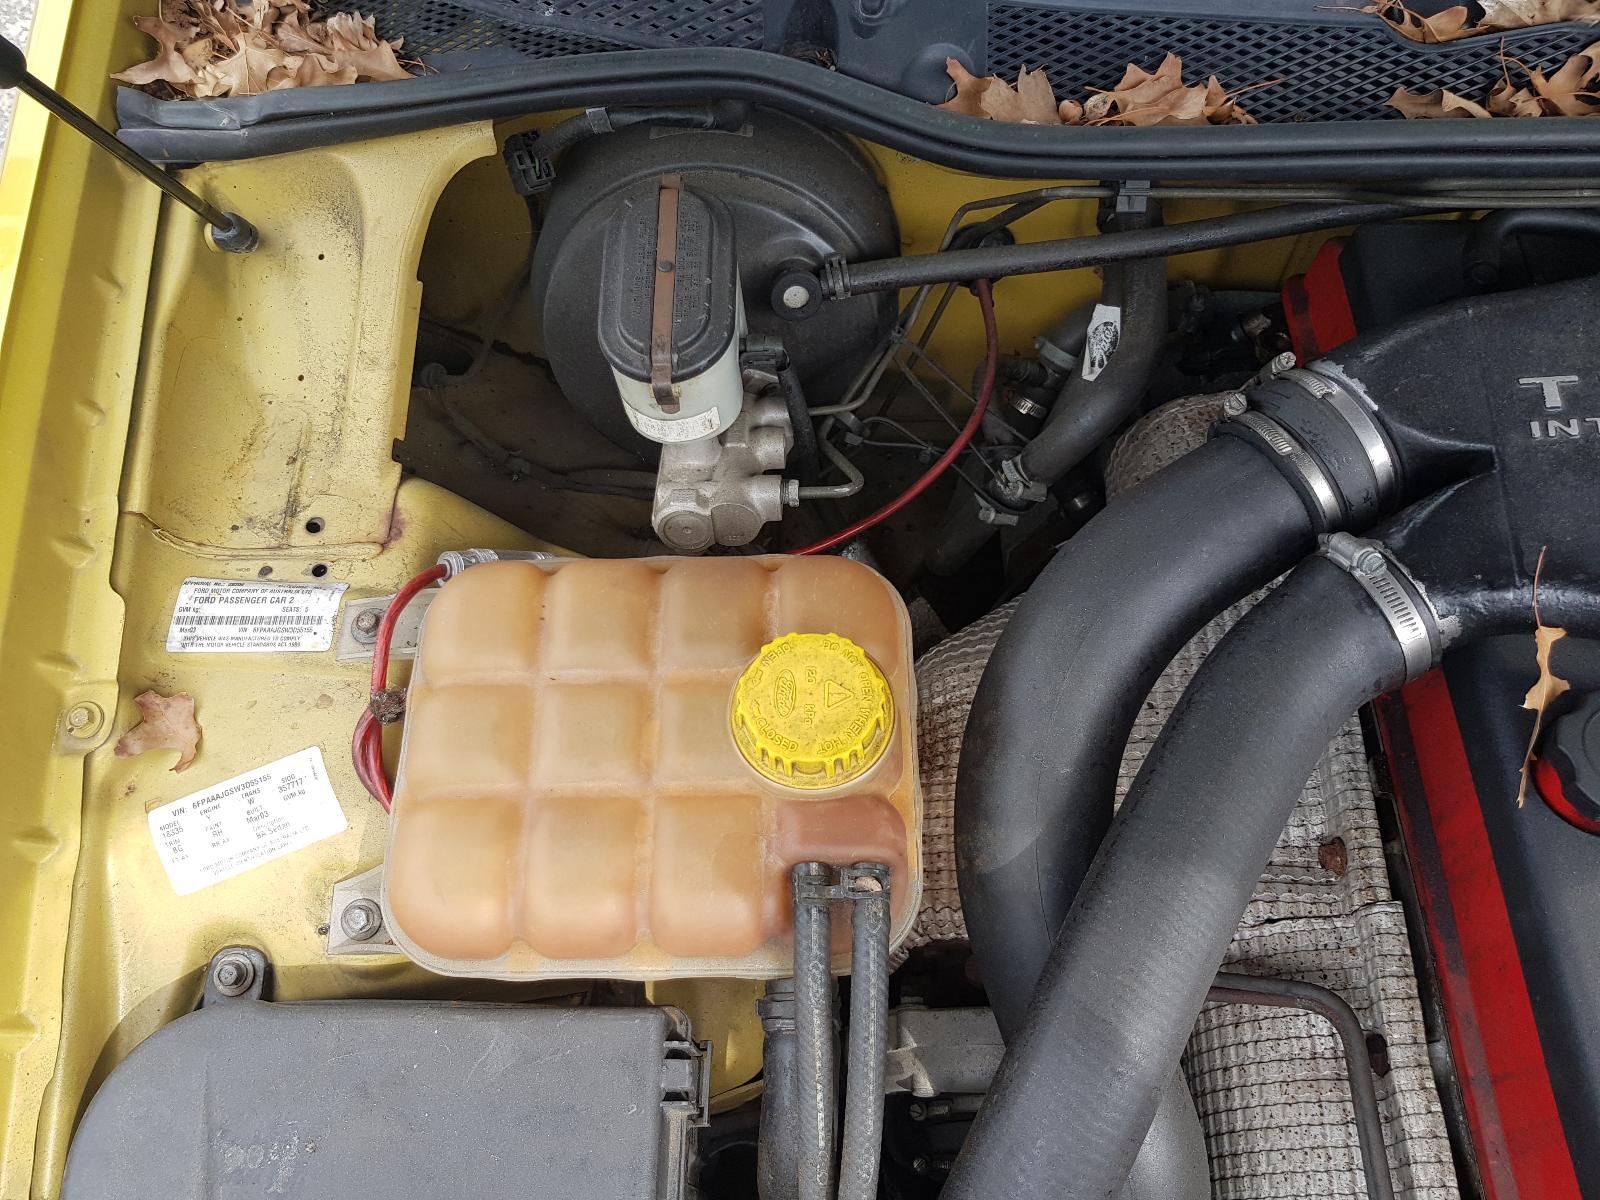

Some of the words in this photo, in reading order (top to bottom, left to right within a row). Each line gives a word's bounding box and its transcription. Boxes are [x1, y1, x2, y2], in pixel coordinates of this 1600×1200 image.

[1518, 375, 1579, 409] T
[193, 596, 216, 604] FORD
[218, 596, 268, 604] PASSENGER
[269, 596, 287, 604] CAR
[289, 596, 295, 604] 2
[761, 641, 792, 667] OPEN
[823, 640, 840, 651] DO
[841, 647, 864, 668] NOT
[775, 672, 795, 718] Ford
[857, 670, 874, 703] OPEN
[756, 718, 799, 753] CLOSED
[845, 706, 871, 740] WHEN
[816, 737, 843, 755] HOT
[247, 797, 255, 805] W
